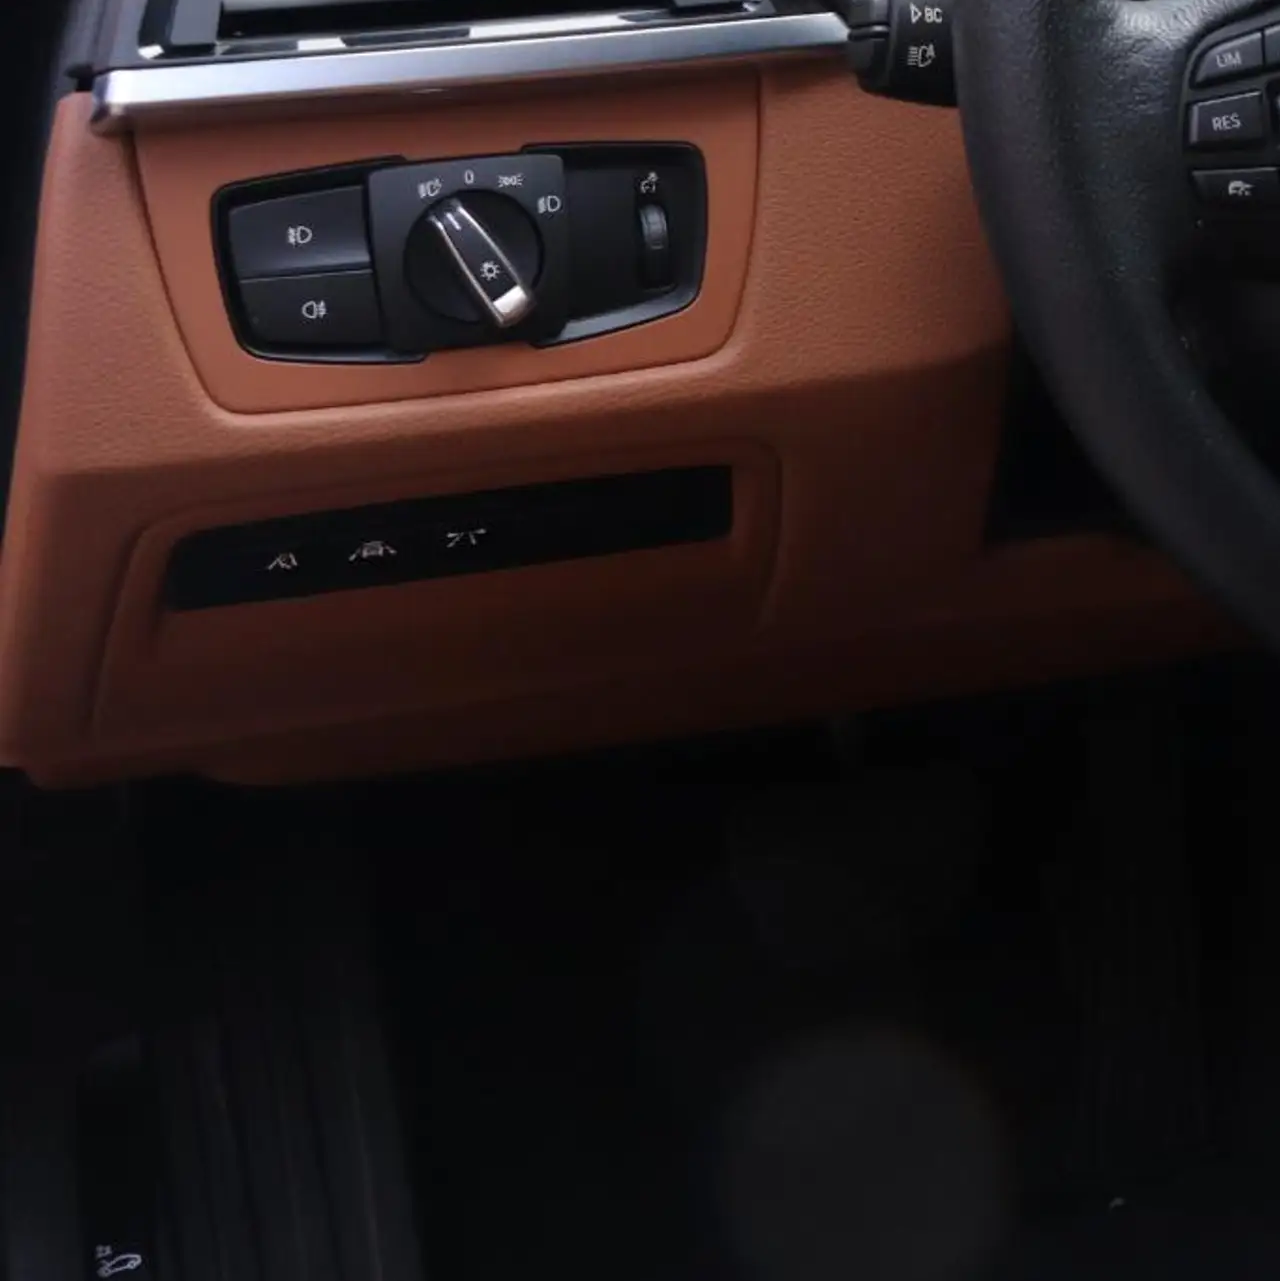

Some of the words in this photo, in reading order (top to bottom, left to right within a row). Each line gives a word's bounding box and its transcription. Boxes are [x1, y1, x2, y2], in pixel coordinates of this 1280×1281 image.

[924, 6, 943, 24] BC
[1215, 51, 1242, 68] LIM
[1211, 114, 1242, 131] RES
